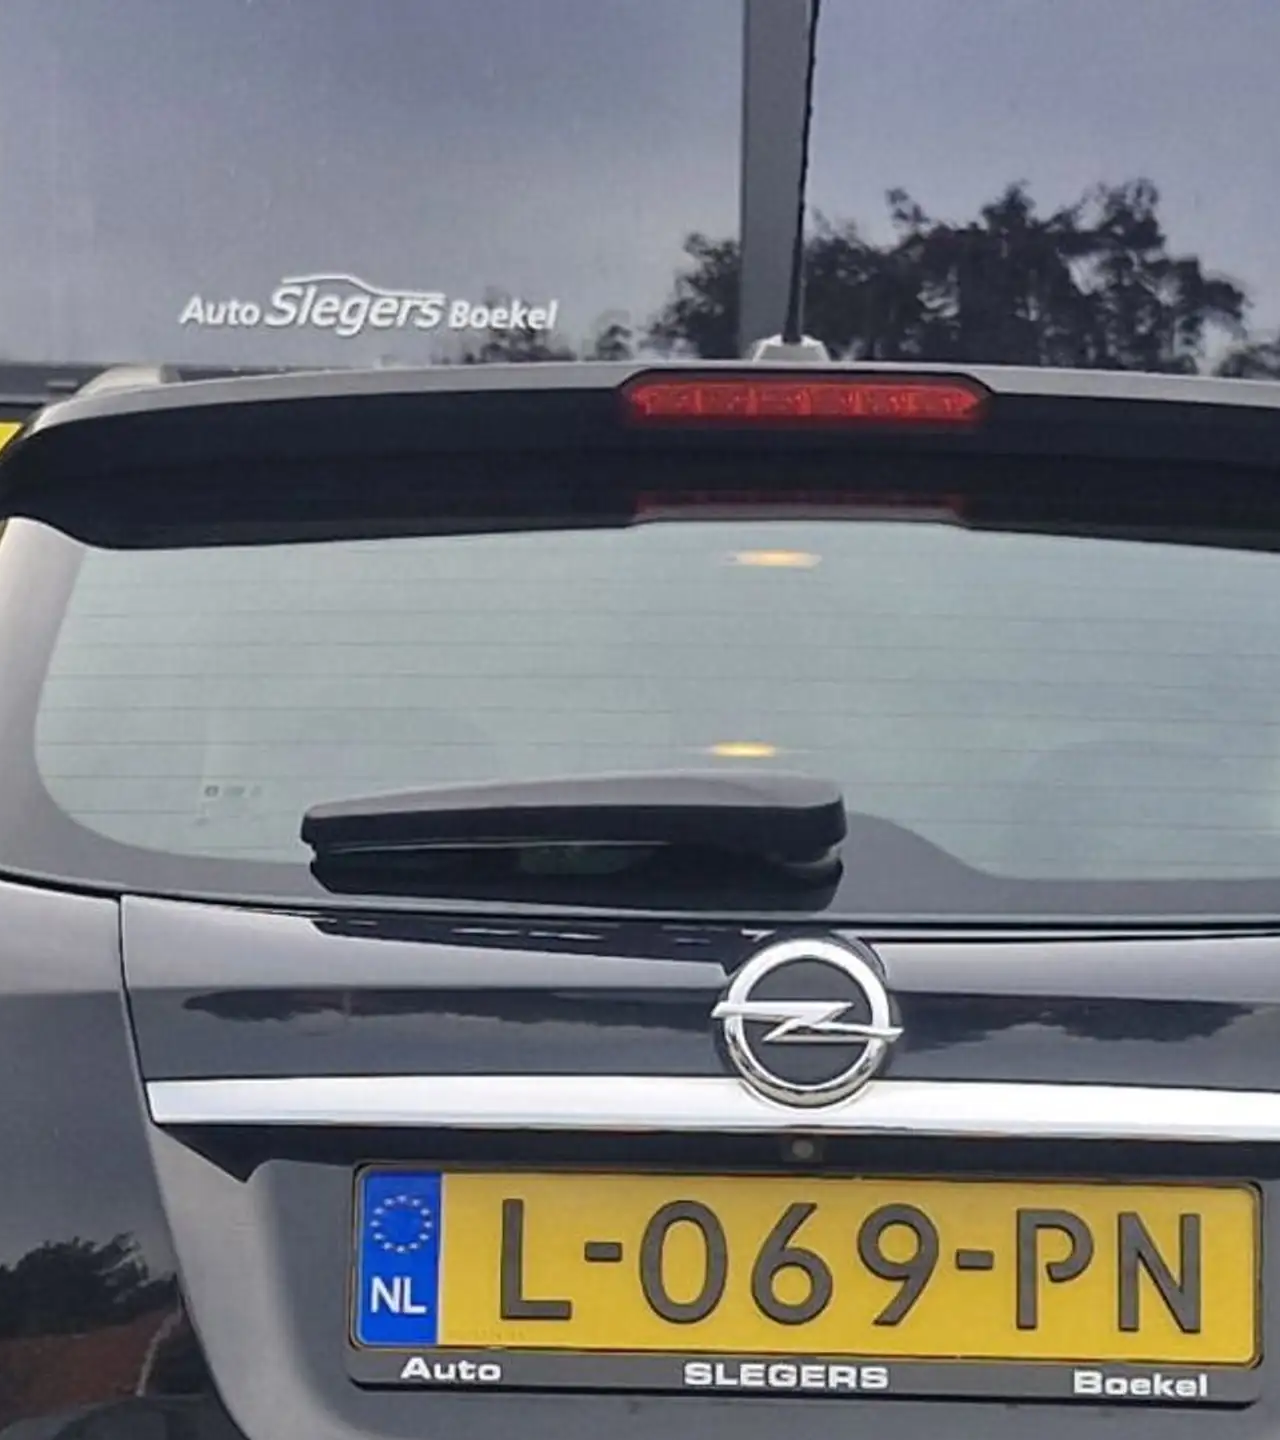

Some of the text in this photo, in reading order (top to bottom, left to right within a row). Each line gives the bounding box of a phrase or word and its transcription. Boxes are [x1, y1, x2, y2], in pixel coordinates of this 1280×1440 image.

[178, 284, 559, 337] Auto Slegers Boekel
[370, 1197, 1202, 1335] NL L-069-PN
[400, 1356, 1208, 1398] Auto SLEGERS Boekel
